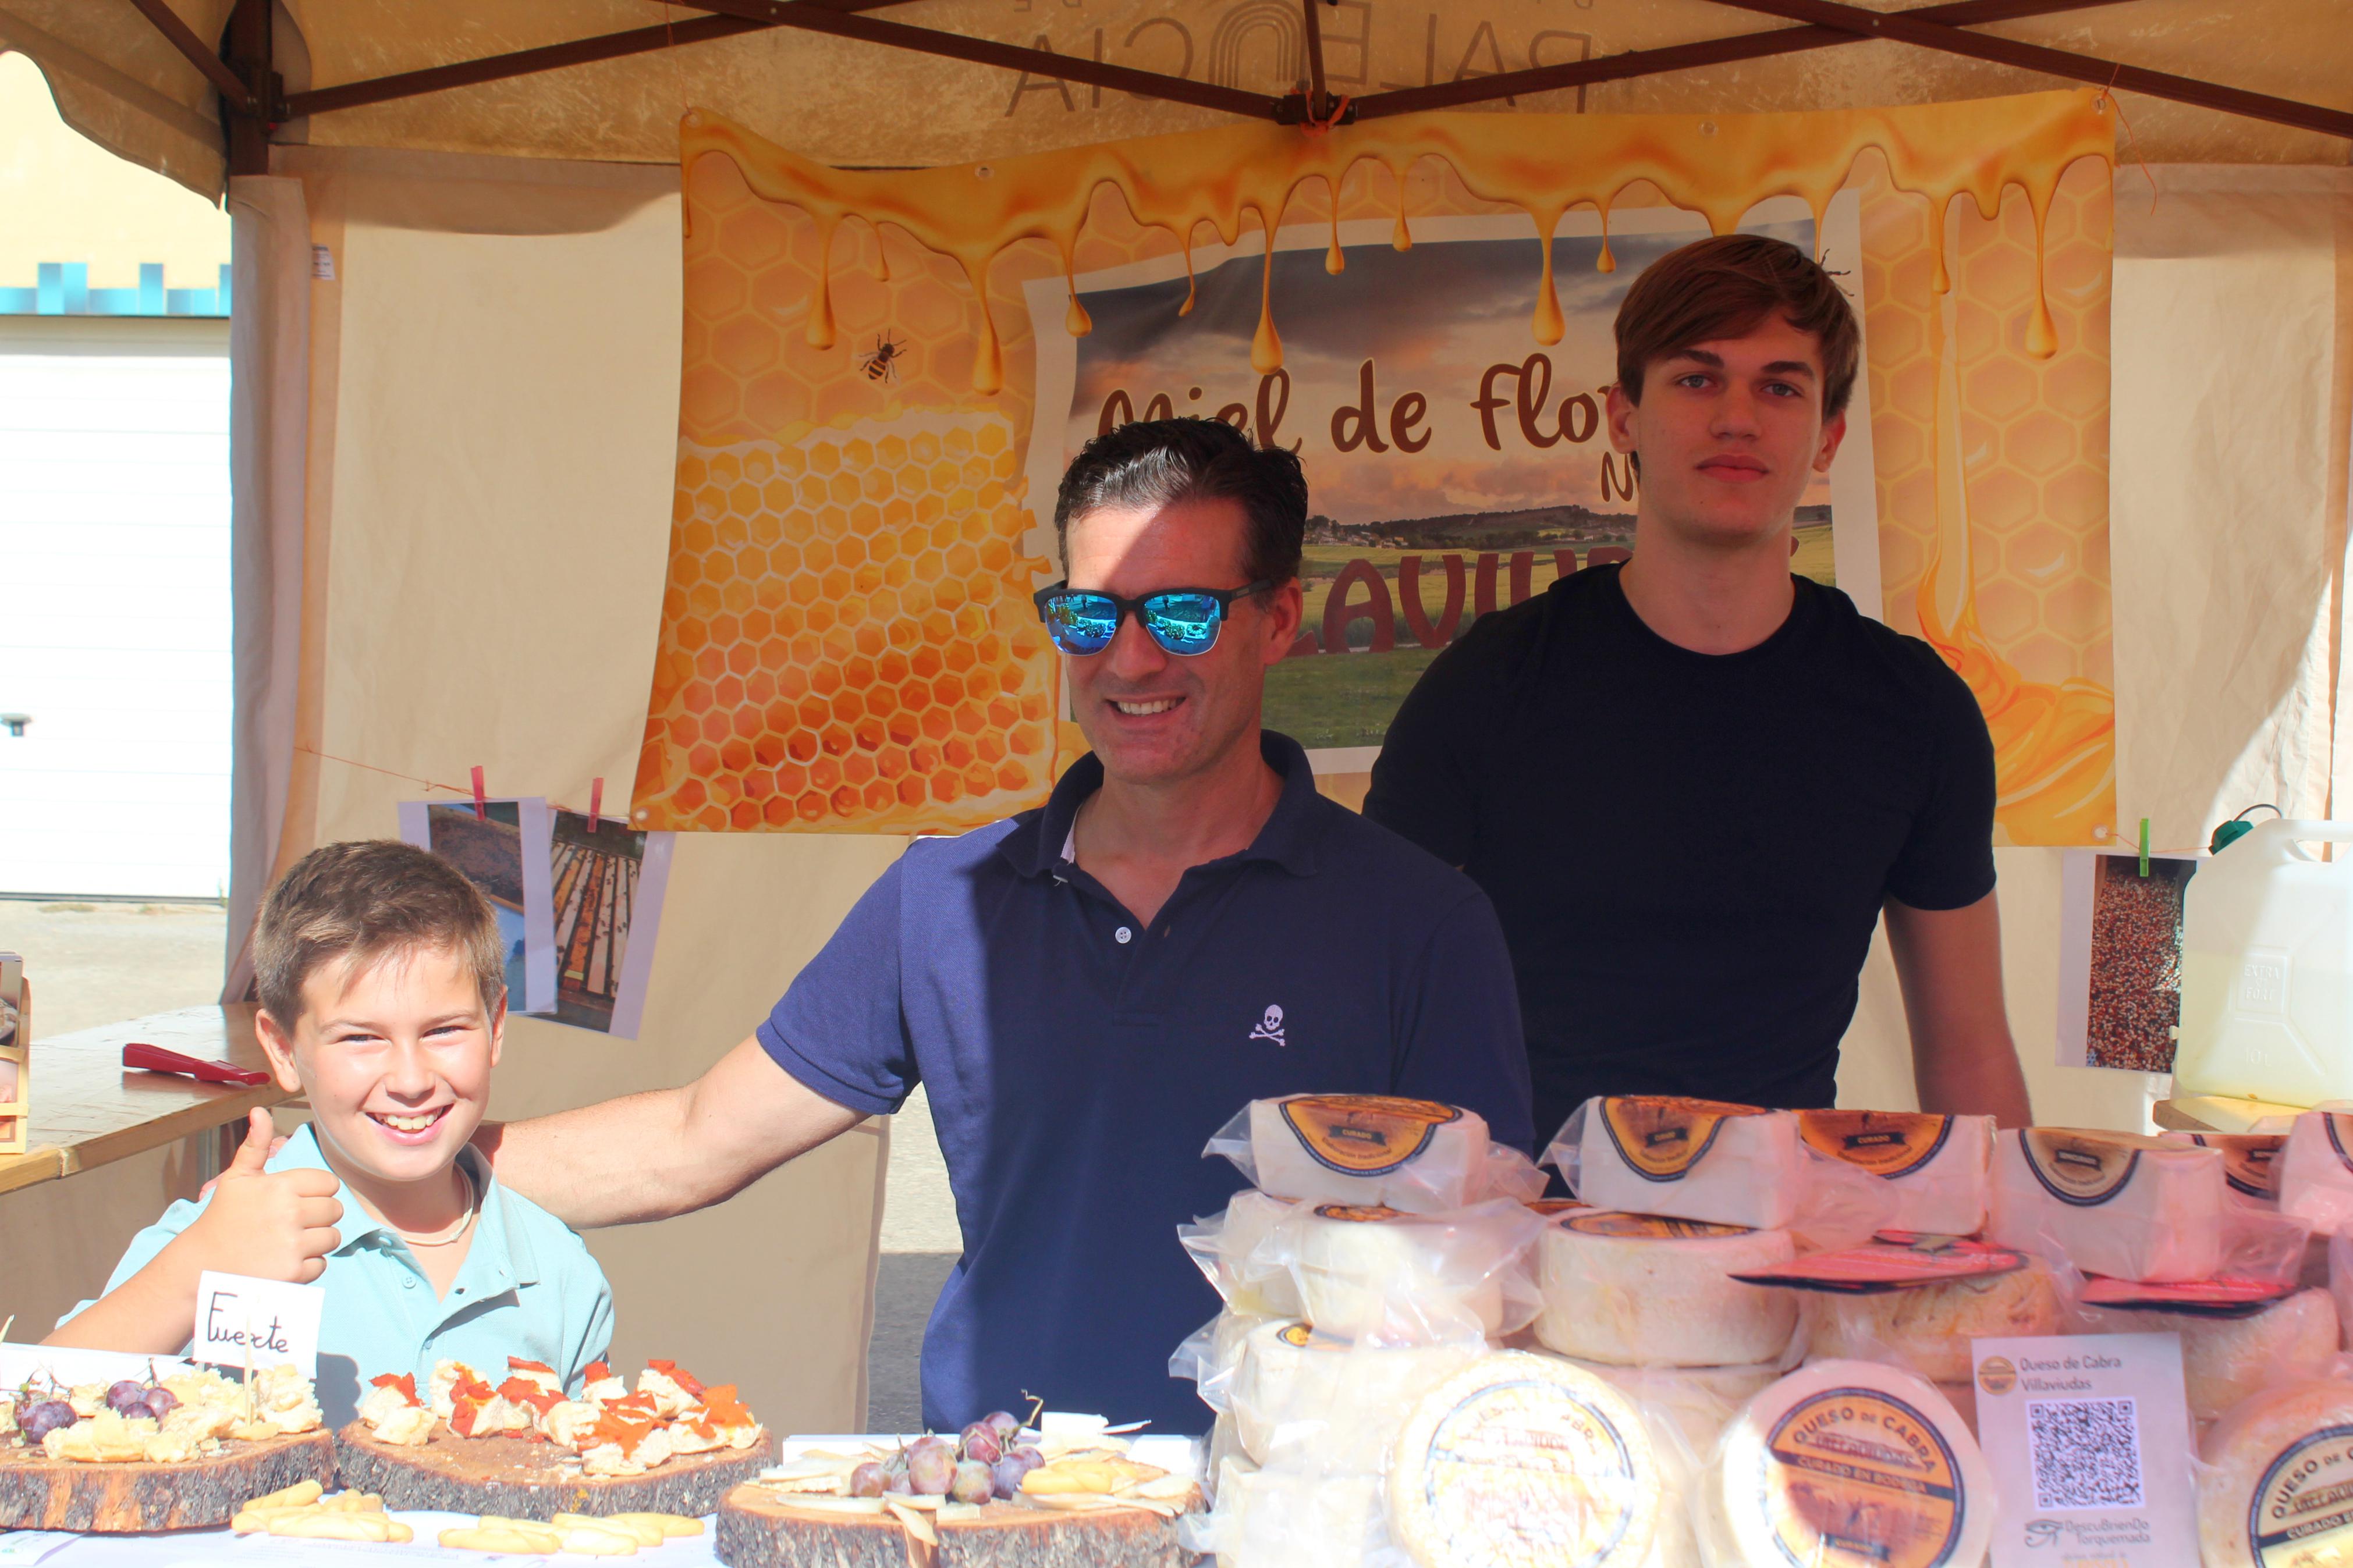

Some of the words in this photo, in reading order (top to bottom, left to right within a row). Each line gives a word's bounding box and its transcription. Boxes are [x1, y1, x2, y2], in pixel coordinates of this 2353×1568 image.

[1331, 357, 1432, 453] de
[1470, 353, 1611, 451] flo
[1342, 1129, 1372, 1139] CURADO
[208, 1291, 289, 1353] Fuerte
[2063, 1355, 2079, 1370] de
[2082, 1354, 2122, 1369] Cabra
[2021, 1377, 2092, 1392] Villaviudas
[1793, 1407, 1854, 1444] QUESO
[1860, 1411, 1877, 1423] DE
[1883, 1417, 1937, 1473] CABRA
[2272, 1459, 2318, 1519] QUESO
[2323, 1453, 2341, 1466] DE
[2287, 1514, 2341, 1539] CURADO
